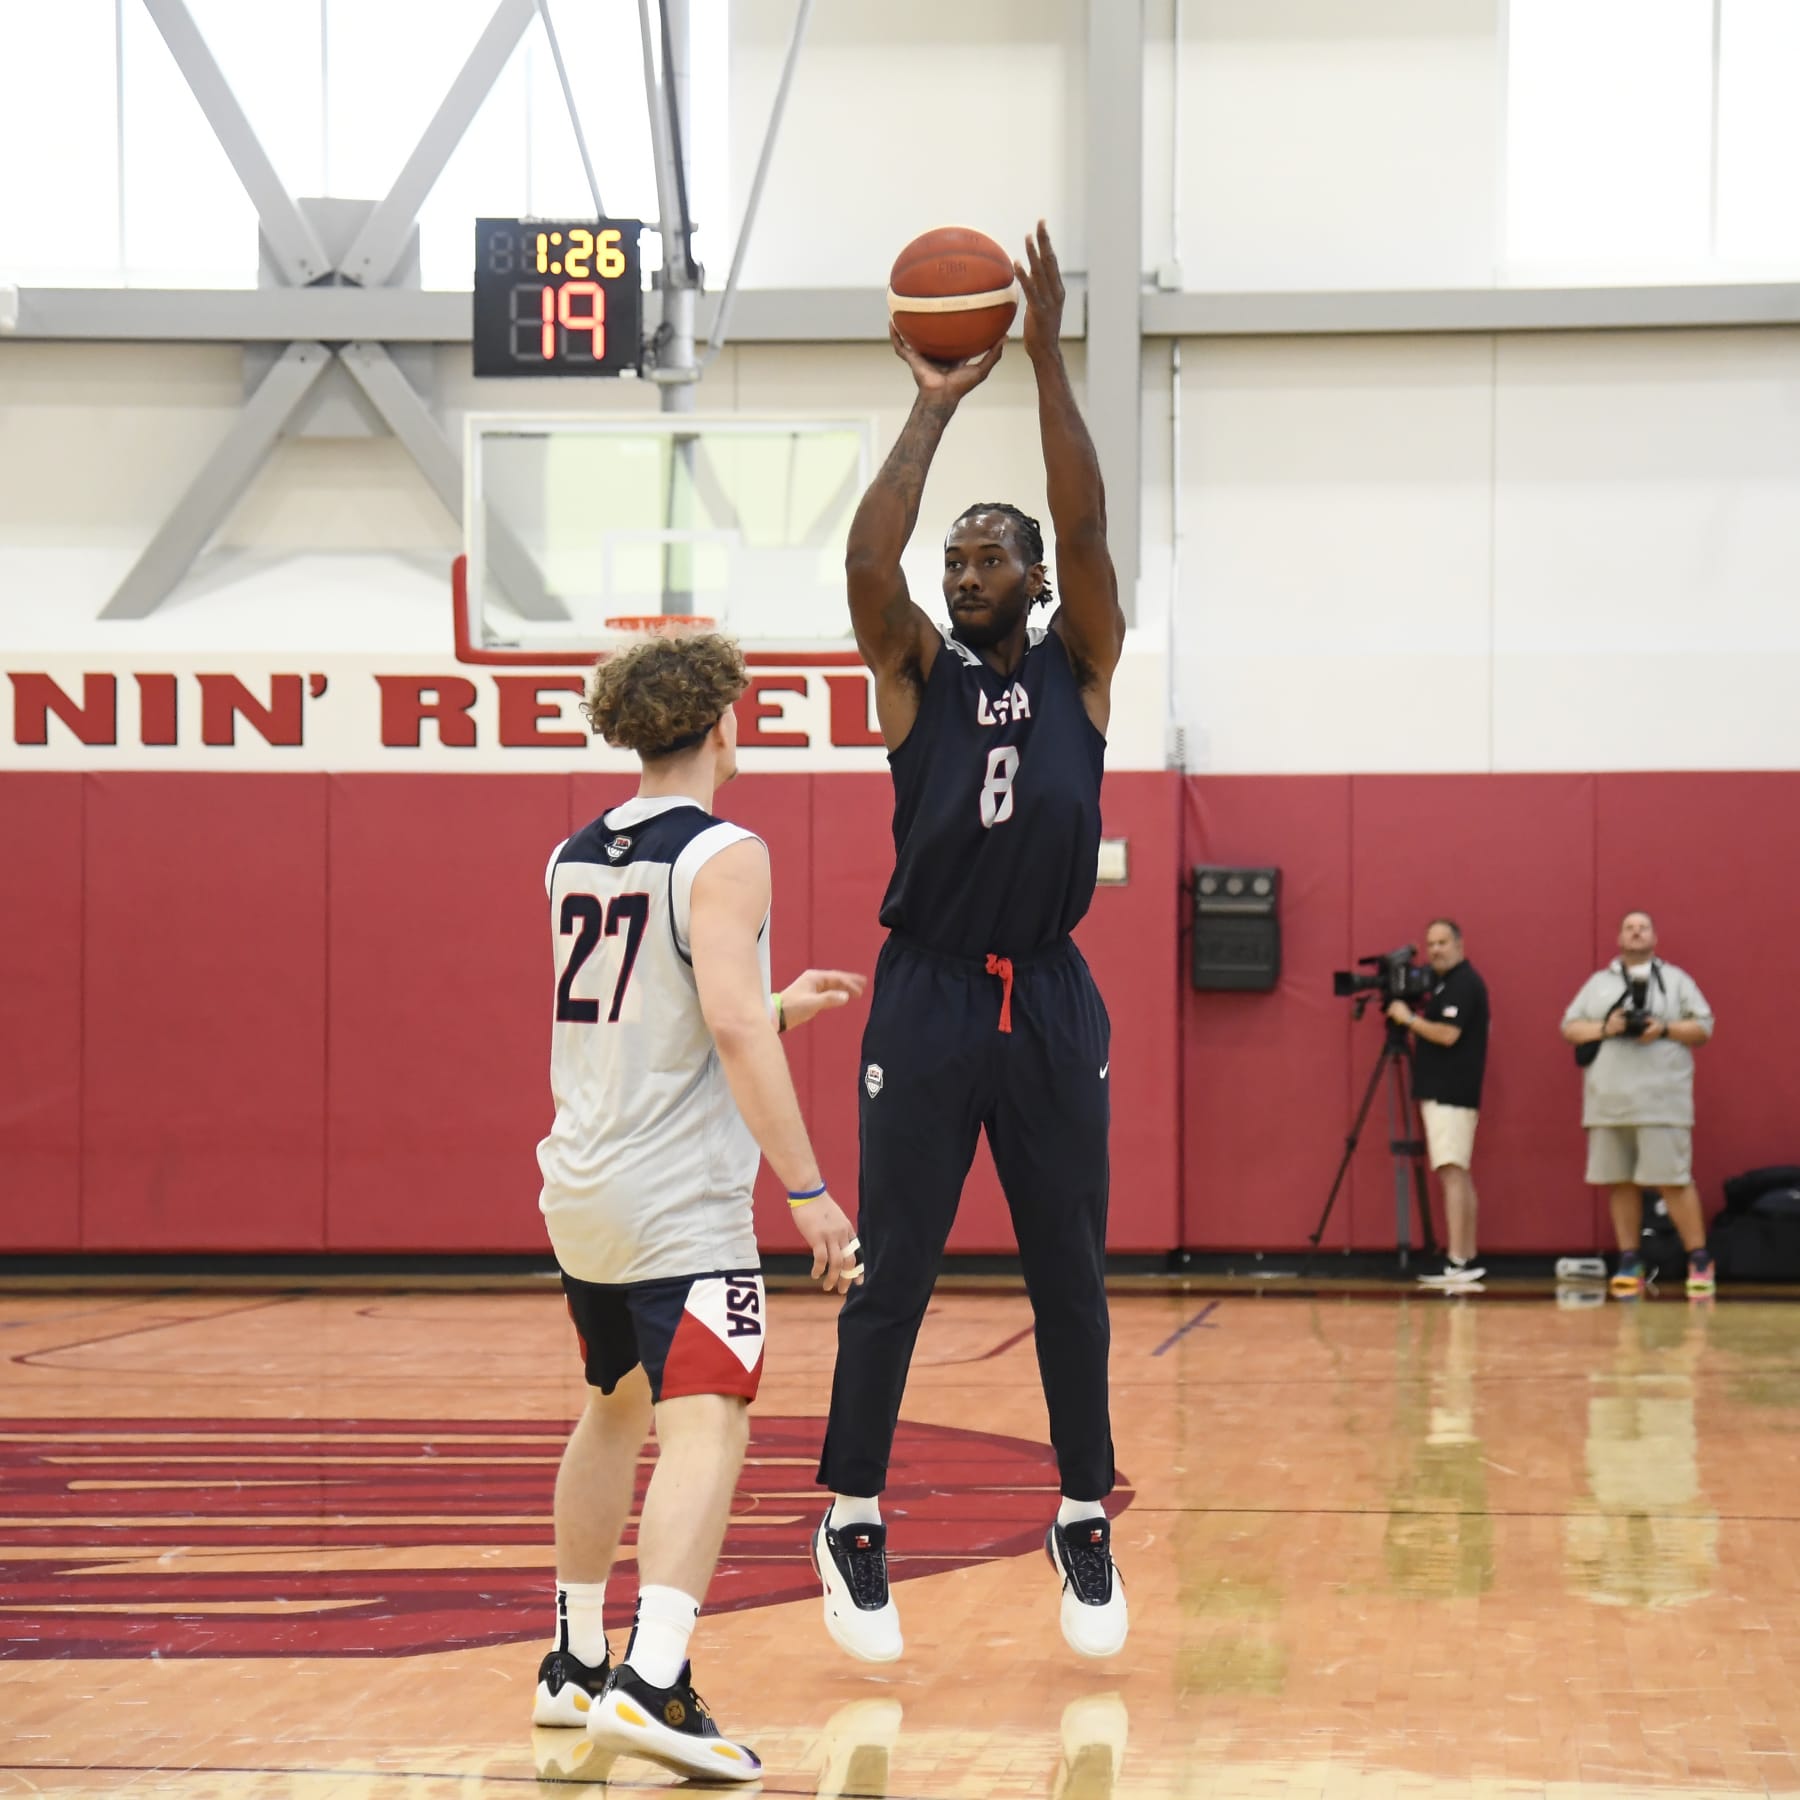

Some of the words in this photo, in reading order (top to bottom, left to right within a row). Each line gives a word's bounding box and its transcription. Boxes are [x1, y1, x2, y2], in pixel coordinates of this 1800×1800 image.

[536, 229, 626, 279] 1:26
[541, 281, 606, 361] 19
[373, 674, 887, 748] REEL
[979, 745, 1020, 830] 8
[556, 892, 650, 1024] 27
[724, 1273, 762, 1338] USA
